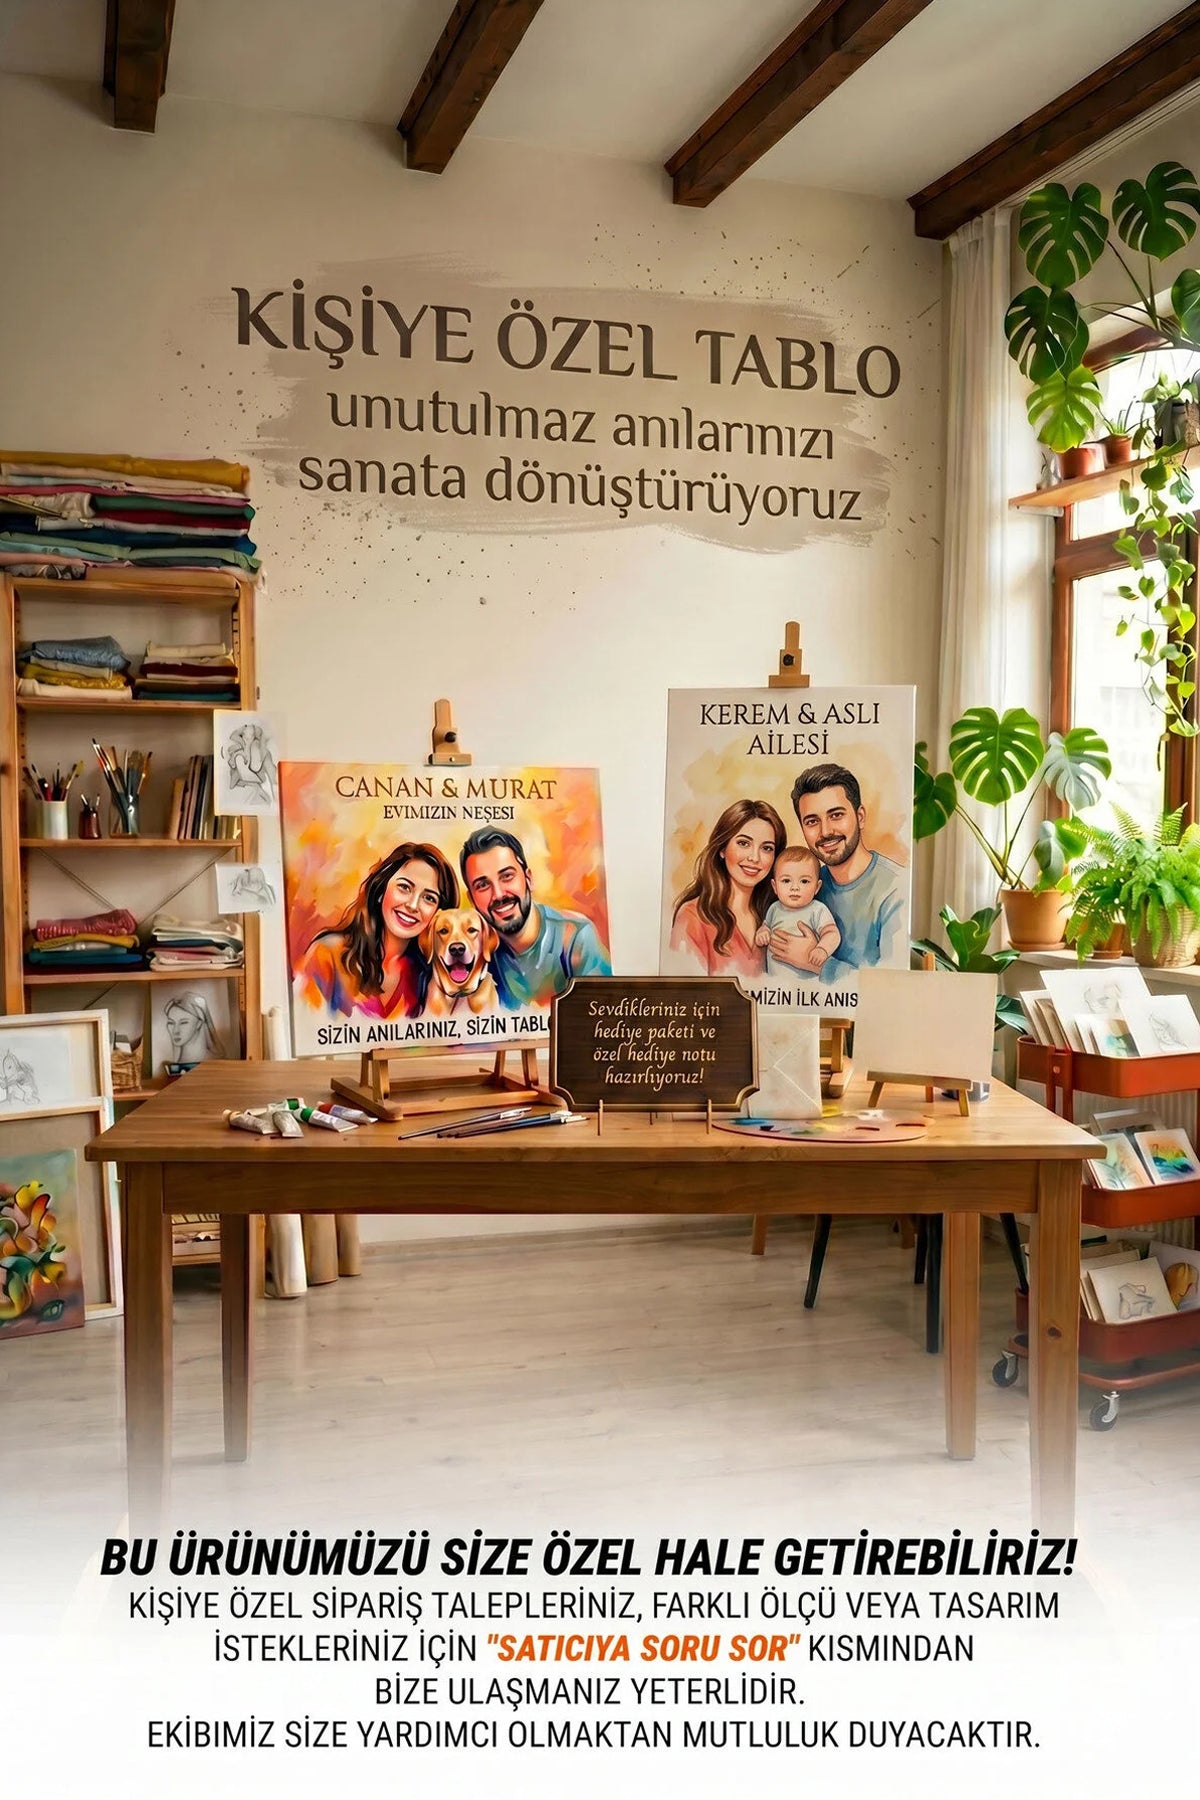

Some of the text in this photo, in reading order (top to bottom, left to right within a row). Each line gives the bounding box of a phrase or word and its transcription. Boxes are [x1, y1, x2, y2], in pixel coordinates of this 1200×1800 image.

[232, 279, 901, 399] KİŞİYE ÖZEL TABLO
[327, 391, 834, 459] unutulmaz anılarınızı
[299, 454, 862, 526] sanata dönüştürüyoruz
[699, 703, 880, 725] KEREM & ASLI
[746, 729, 829, 755] AİLESİ
[335, 775, 558, 800] CANAN & MURAT
[588, 997, 720, 1020] Sevdikleriniz için
[745, 987, 792, 1006] MİZİN
[797, 988, 820, 1007] İLK
[317, 1023, 360, 1045] SİZİN
[366, 1019, 461, 1042] ANILARINIZ,
[466, 1014, 506, 1036] SİZİN
[594, 1020, 716, 1046] hediye paketi ve
[593, 1042, 716, 1069] özel hediye notu
[605, 1065, 704, 1092] hazırlıyoruz!
